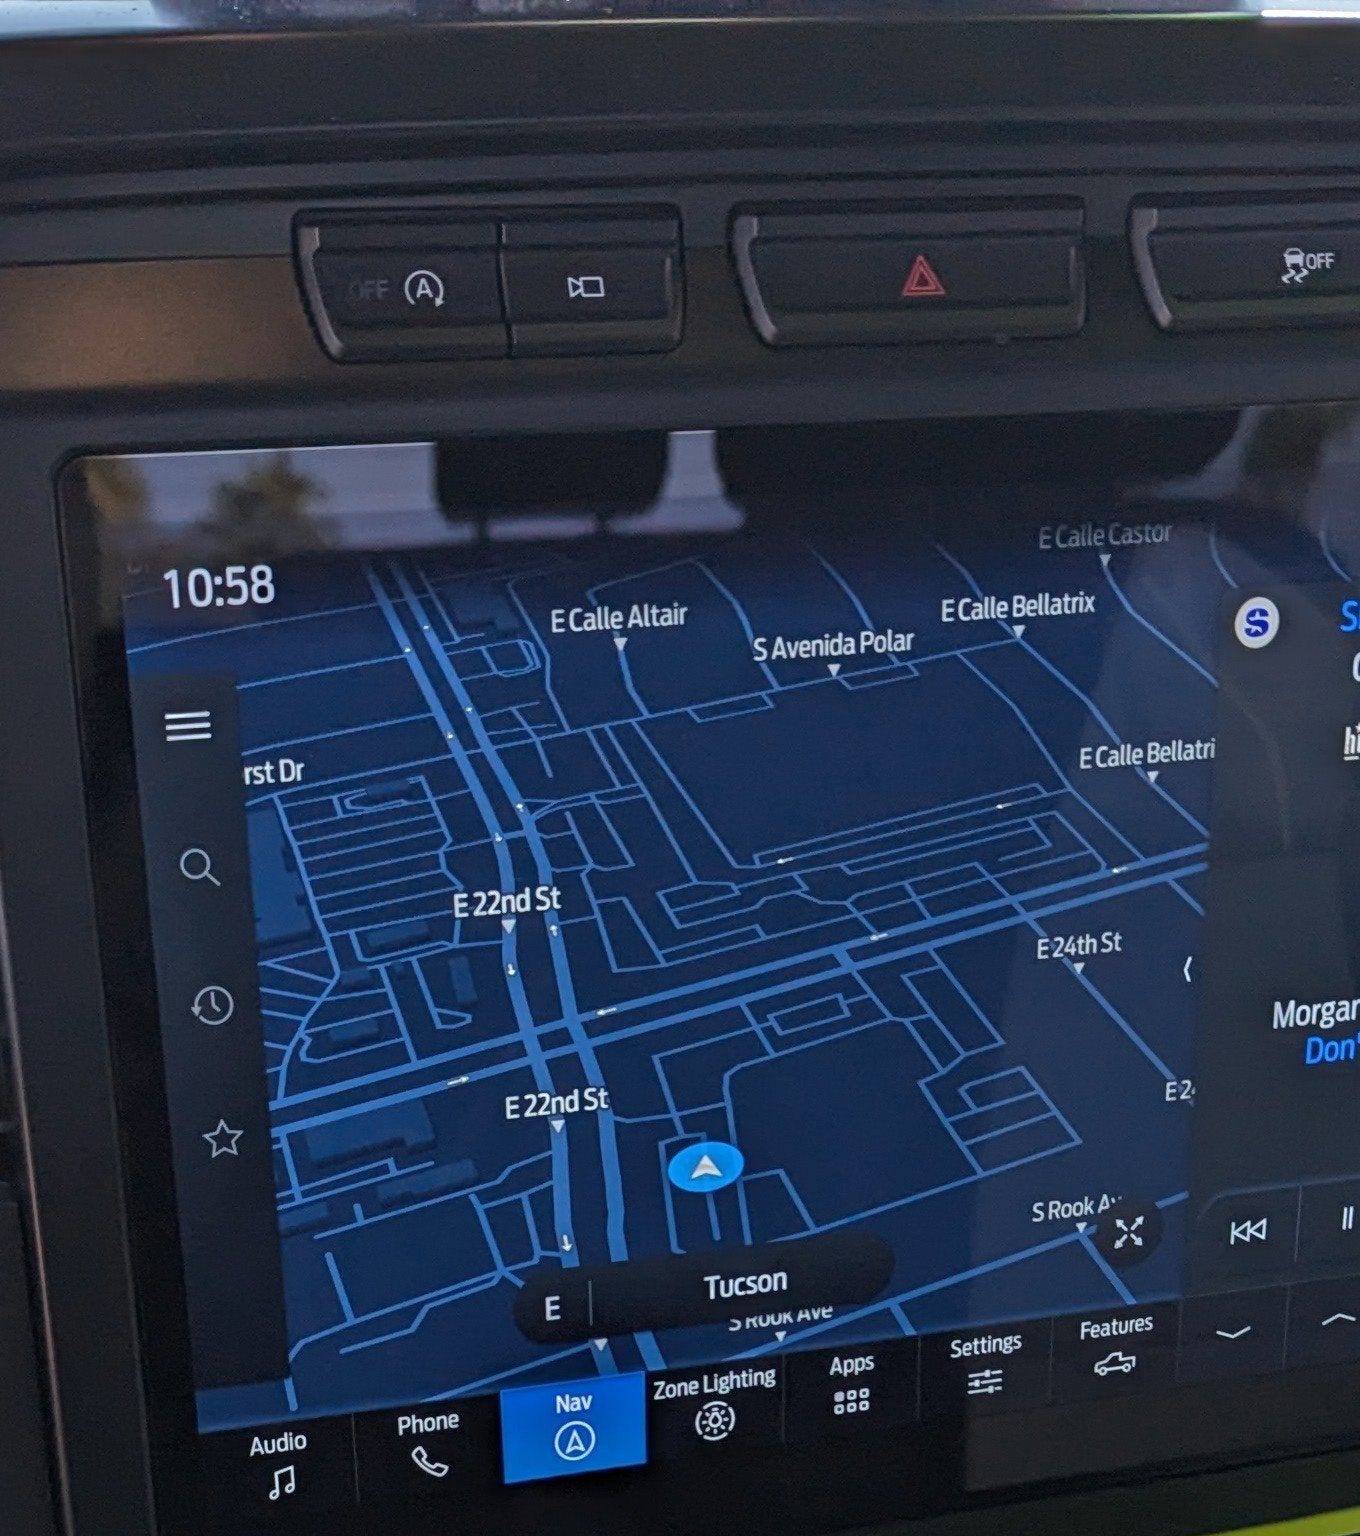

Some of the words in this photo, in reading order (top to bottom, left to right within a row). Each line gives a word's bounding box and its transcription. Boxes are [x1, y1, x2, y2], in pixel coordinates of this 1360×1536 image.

[1306, 252, 1336, 270] OFF
[1040, 525, 1053, 549] E
[1055, 522, 1108, 548] Calle
[1111, 521, 1172, 546] Castor
[163, 564, 276, 611] 10:58
[550, 609, 566, 634] E
[568, 605, 623, 633] Calle
[627, 602, 688, 630] Altair
[941, 599, 955, 623] E
[957, 593, 1008, 621] Calle
[1011, 591, 1096, 619] Bellatrix
[752, 636, 767, 662] S
[771, 632, 856, 660] Avenida
[860, 629, 914, 656] Polar
[1079, 747, 1092, 770] E
[1094, 742, 1143, 769] Calle
[1146, 736, 1215, 766] Bellatri
[243, 762, 275, 786] rst
[278, 759, 305, 783] Dr
[453, 895, 469, 918] E
[472, 888, 531, 917] 22nd
[535, 886, 562, 912] St
[1037, 937, 1050, 960] E
[1052, 933, 1098, 959] 24th
[1102, 930, 1122, 955] St
[505, 1095, 520, 1120] E
[523, 1090, 580, 1118] 22nd
[583, 1086, 609, 1112] St
[1165, 1081, 1178, 1102] E
[1032, 1202, 1045, 1223] S
[1048, 1195, 1095, 1221] Rook
[704, 1267, 788, 1301] Tucson
[545, 1296, 561, 1321] E
[1080, 1312, 1154, 1341] Features
[950, 1331, 1023, 1361] Settings
[829, 1352, 875, 1380] Apps
[653, 1375, 699, 1401] Zone
[702, 1365, 777, 1397] Lighting
[555, 1392, 592, 1414] Nav
[397, 1408, 460, 1435] Phone
[249, 1430, 307, 1456] Audio
